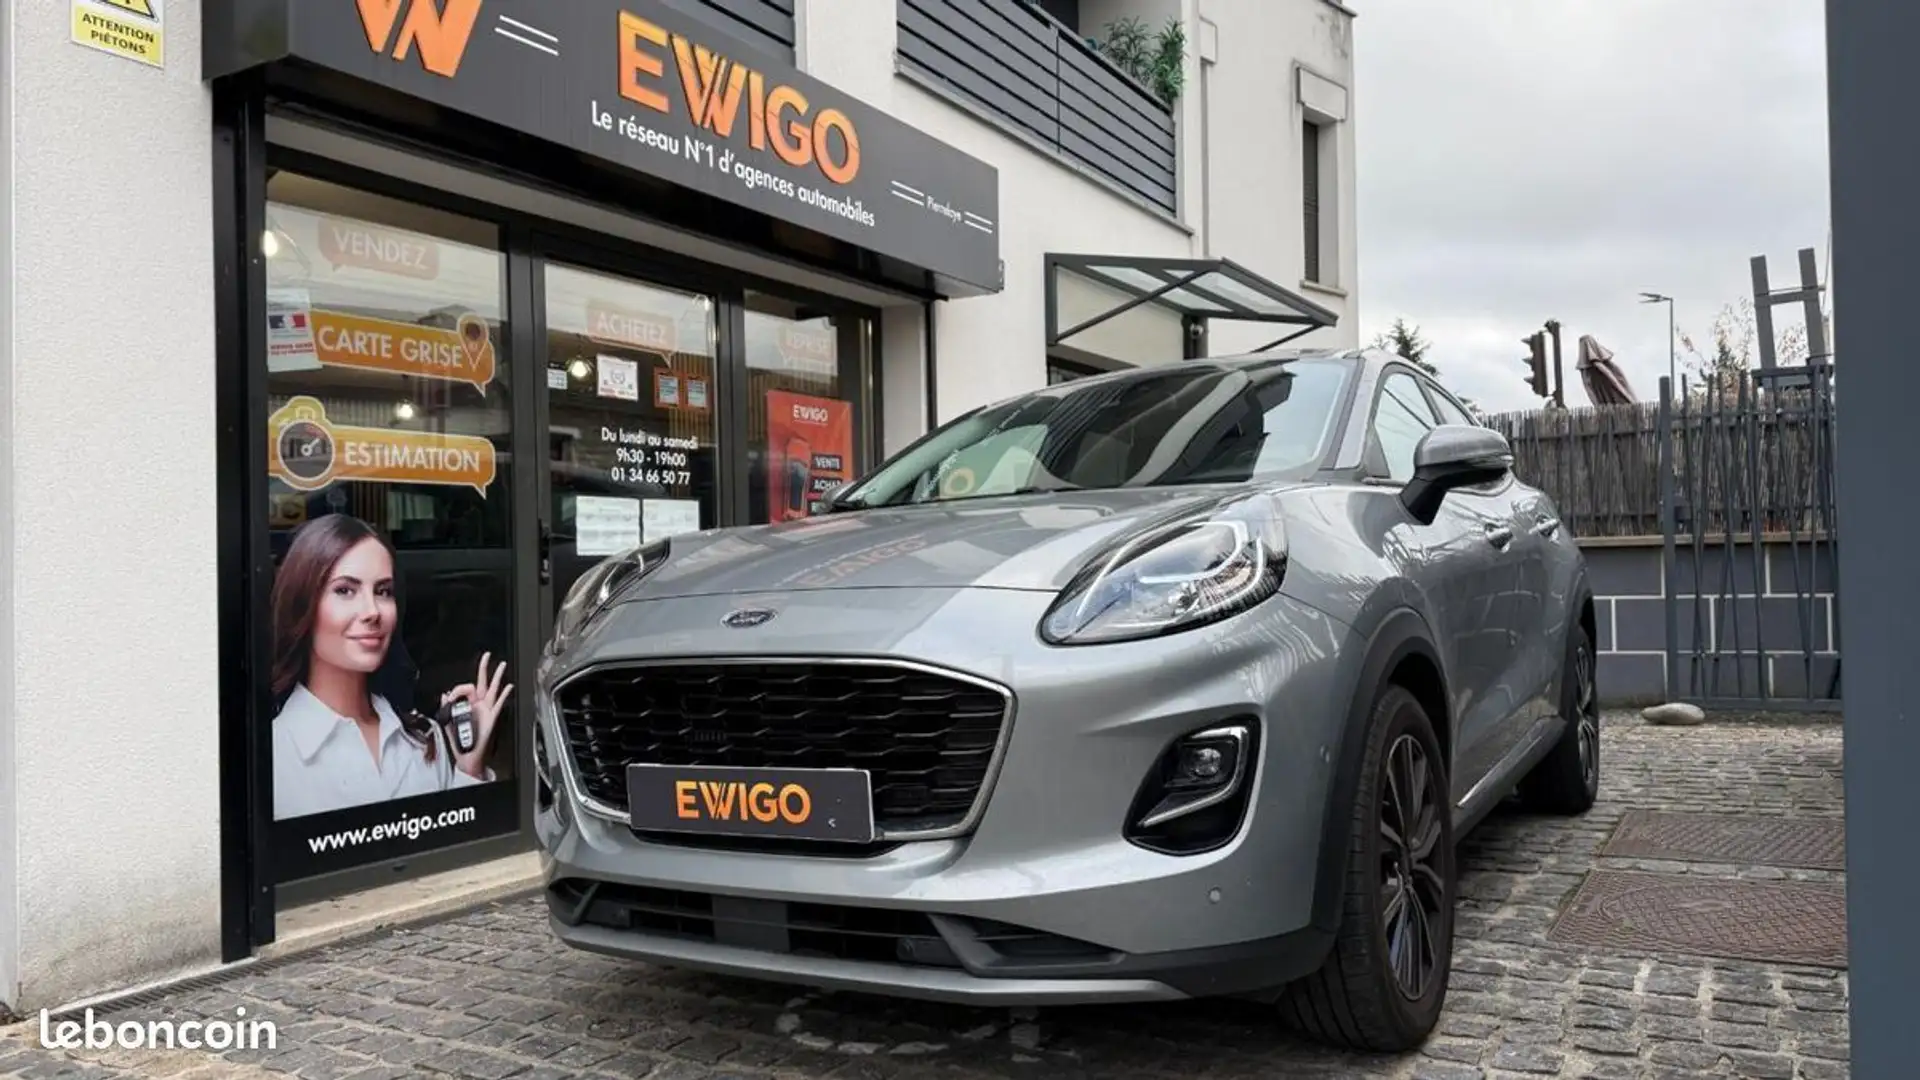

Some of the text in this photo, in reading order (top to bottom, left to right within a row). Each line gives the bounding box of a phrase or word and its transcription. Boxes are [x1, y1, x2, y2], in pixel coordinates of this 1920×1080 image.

[83, 13, 154, 42] ATTENTION
[91, 30, 146, 54] PIÉTONS
[617, 10, 861, 184] EWIGO
[591, 100, 612, 130] Le
[618, 115, 679, 154] réseau
[685, 135, 714, 168] N°1
[798, 185, 875, 227] automobiles
[332, 227, 428, 270] VENDEZ
[596, 311, 666, 342] ACHETEZ
[318, 325, 392, 358] CARTE
[400, 338, 463, 368] GRISE
[601, 427, 699, 449] Du lundi au samedi
[343, 442, 480, 472] ESTIMATION
[616, 448, 644, 463] 9h30
[655, 451, 686, 466] 19h00
[611, 466, 691, 485] 01 34 66 50 77
[675, 780, 811, 823] EWIGO
[308, 806, 476, 853] www.ewigo.com
